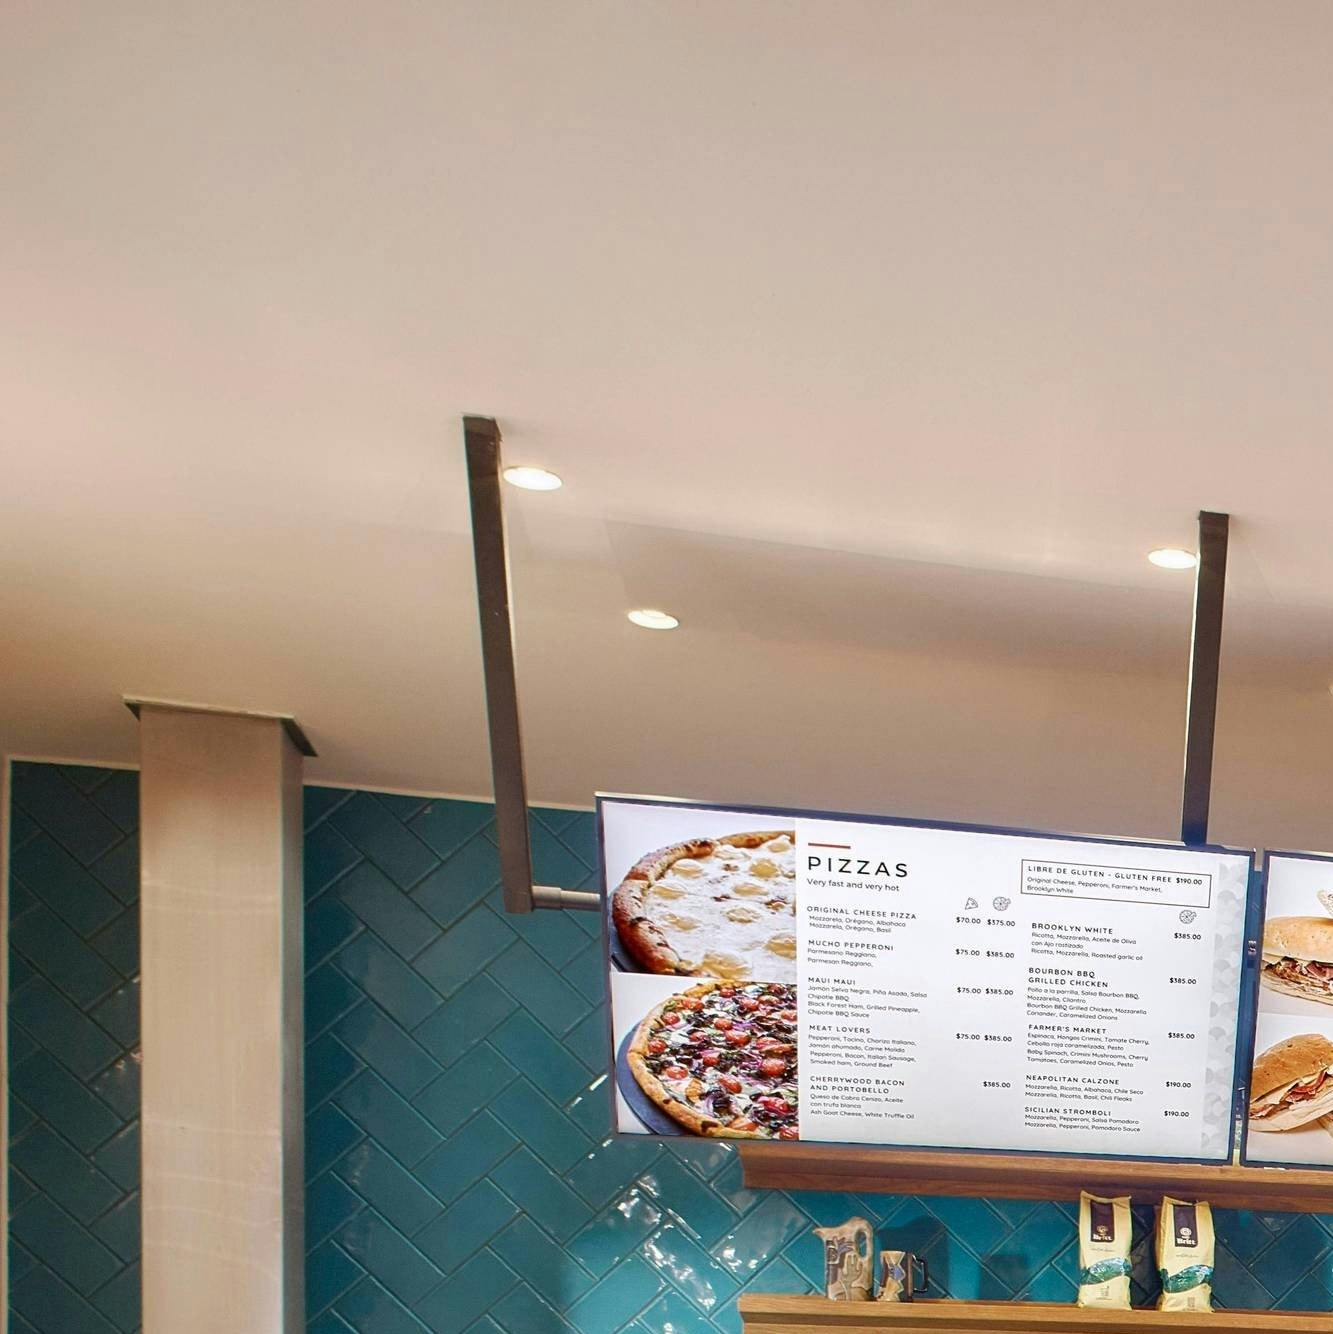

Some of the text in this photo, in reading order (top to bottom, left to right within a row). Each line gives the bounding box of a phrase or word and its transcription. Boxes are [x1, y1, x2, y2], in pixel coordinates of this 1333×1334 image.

[808, 856, 907, 878] PIZZAS
[1071, 869, 1104, 877] GLUTEN
[1114, 872, 1148, 880] GLUTEN
[1176, 877, 1202, 885] $190.00
[806, 878, 899, 892] Very fast and very hot
[806, 906, 850, 914] ORIGINAL
[853, 909, 886, 917] CHEESE
[956, 916, 981, 924] $70.00
[1032, 922, 1081, 932] BROOKLYN
[1174, 932, 1201, 940] $385.00
[808, 940, 894, 951] MUCHO PEPPERONI
[1029, 967, 1095, 978] BOURBON BBQ
[1028, 977, 1108, 988] GRILLED CHICKEN
[836, 1026, 870, 1034] LOVERS
[1028, 1024, 1070, 1032] FARMER'S
[1025, 1106, 1110, 1116] SICILIAN STROMBOLI
